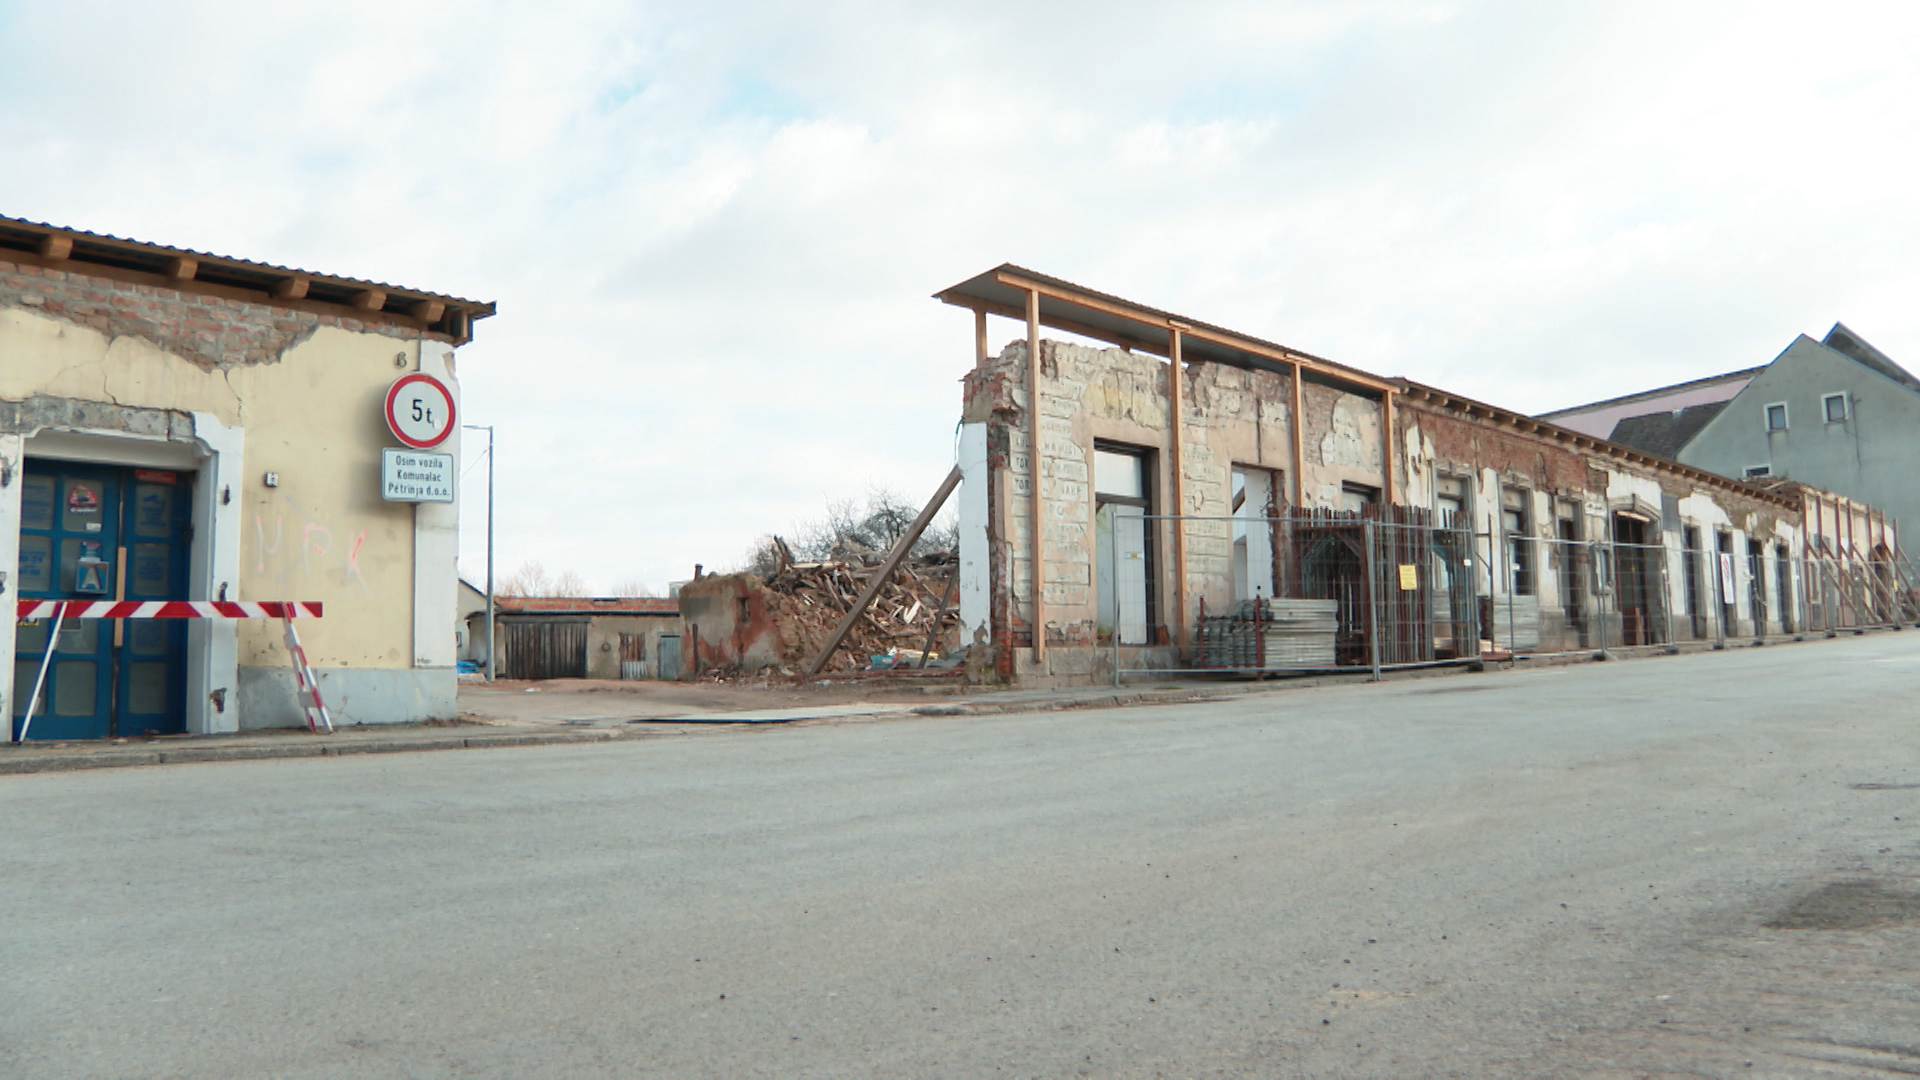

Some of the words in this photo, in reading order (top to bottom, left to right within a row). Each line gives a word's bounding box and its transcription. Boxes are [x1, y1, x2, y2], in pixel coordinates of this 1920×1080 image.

[395, 455, 416, 466] Osim
[419, 458, 443, 468] vozila
[397, 469, 442, 482] Komunalac
[388, 482, 424, 498] Petrinja
[426, 486, 450, 496] d.o.o.
